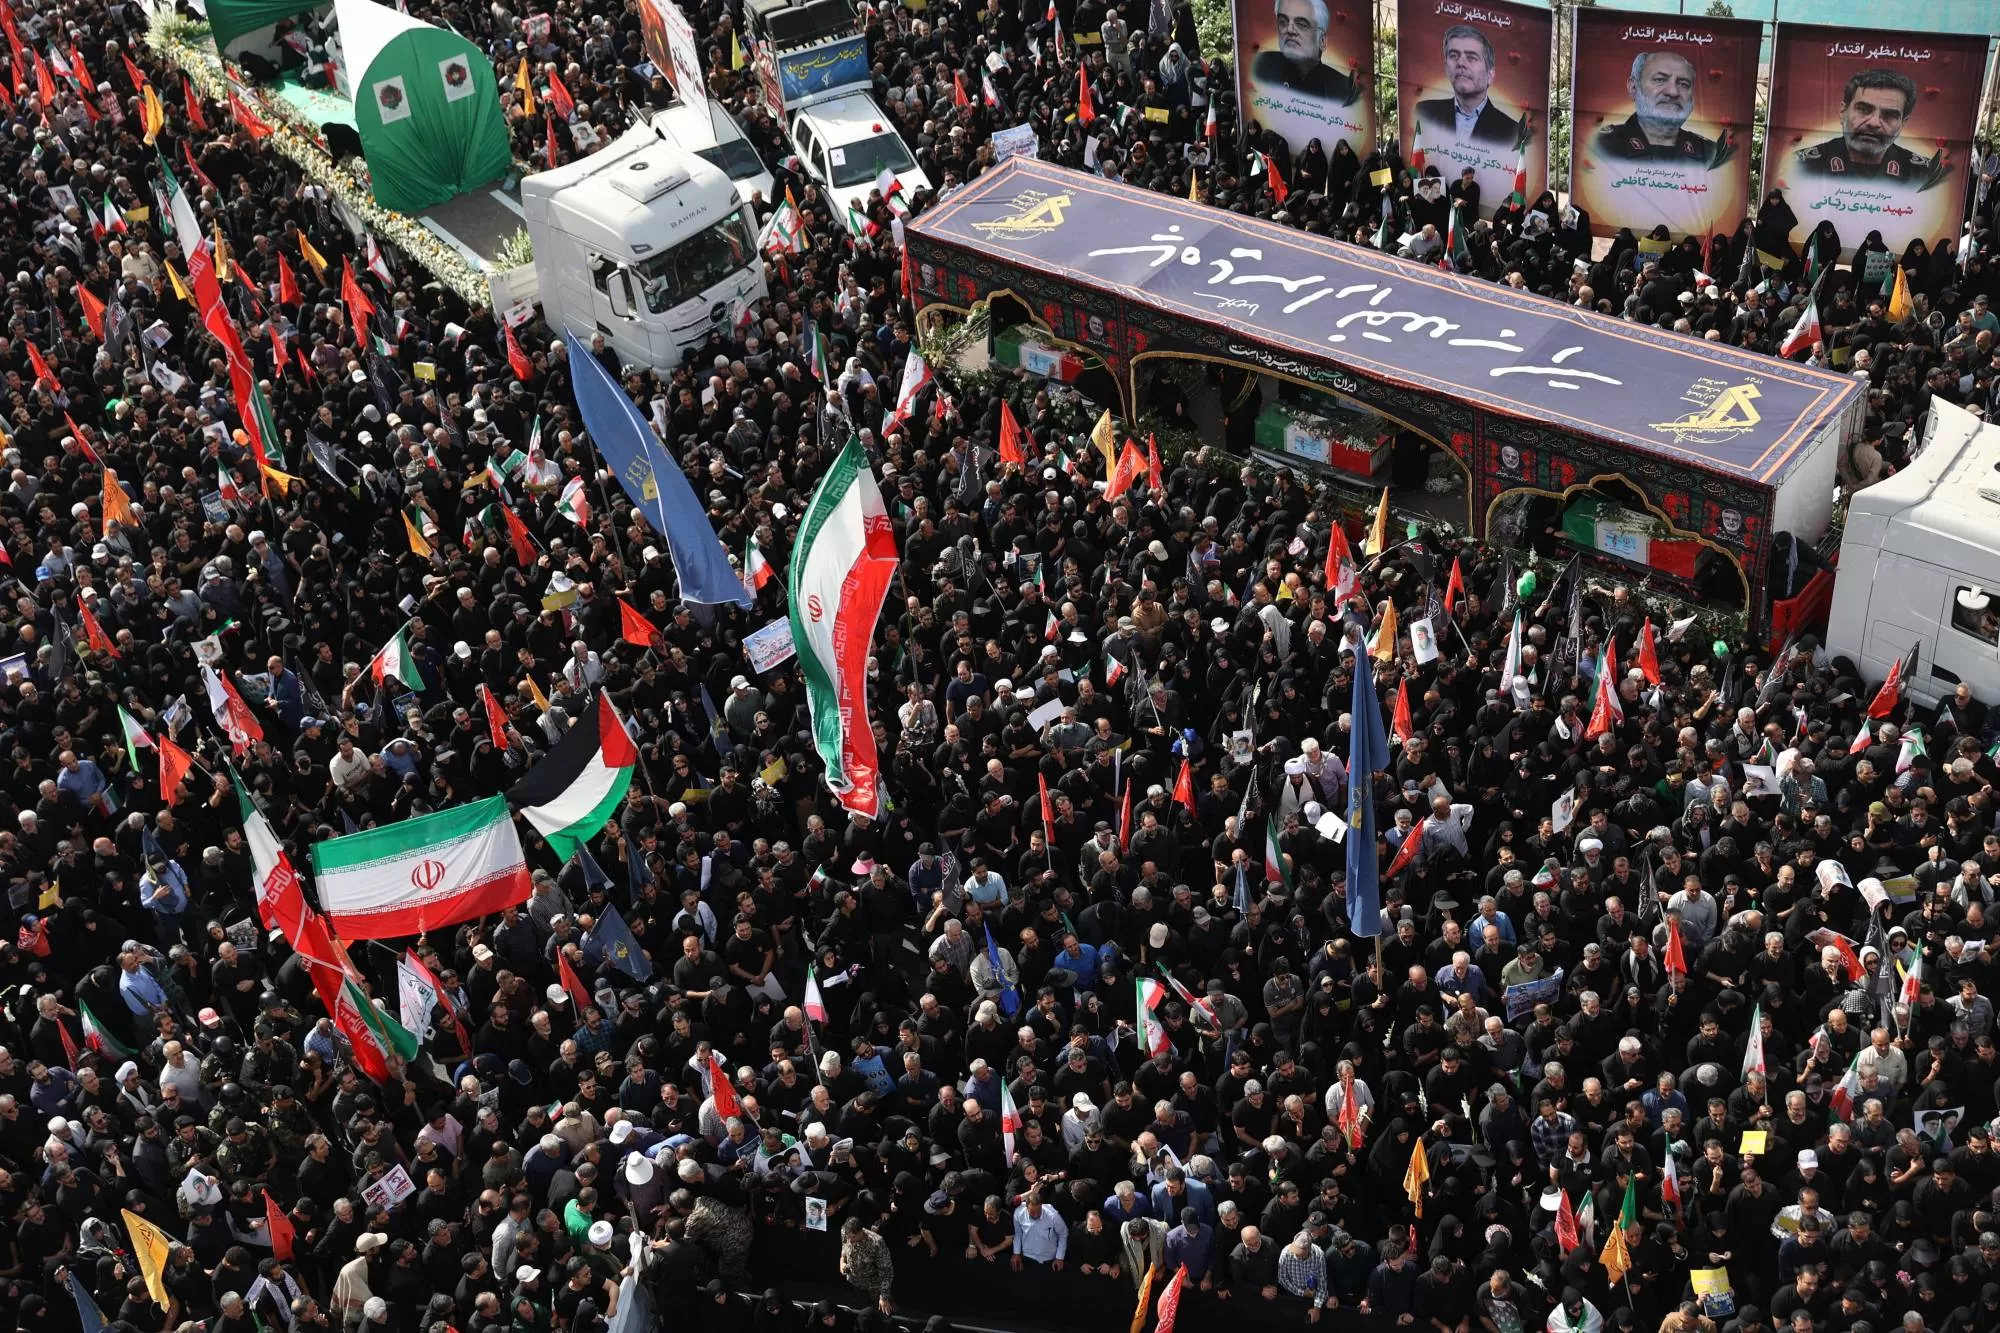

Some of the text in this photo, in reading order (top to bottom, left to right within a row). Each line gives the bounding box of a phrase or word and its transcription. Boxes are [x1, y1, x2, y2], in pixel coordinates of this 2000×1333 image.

[1435, 2, 1511, 27] شهدا مظهر اقتدار
[1622, 26, 1713, 45] شهدا مظهر اقتدار
[1826, 42, 1931, 62] شهدا مظهر اقتدار
[1252, 97, 1283, 110] طهرانچی
[1327, 116, 1343, 126] دکتر
[1344, 121, 1363, 132] شهید
[1424, 144, 1449, 156] عباسی
[1451, 150, 1480, 166] فریدون
[1482, 160, 1501, 169] دکتر
[1611, 176, 1708, 194] شهید محمد کاظمی
[1848, 201, 1881, 214] مهدی
[1883, 205, 1913, 216] شهید
[670, 205, 707, 229] BAHMAN
[1309, 365, 1343, 381] حسین
[1333, 376, 1357, 392] ایران
